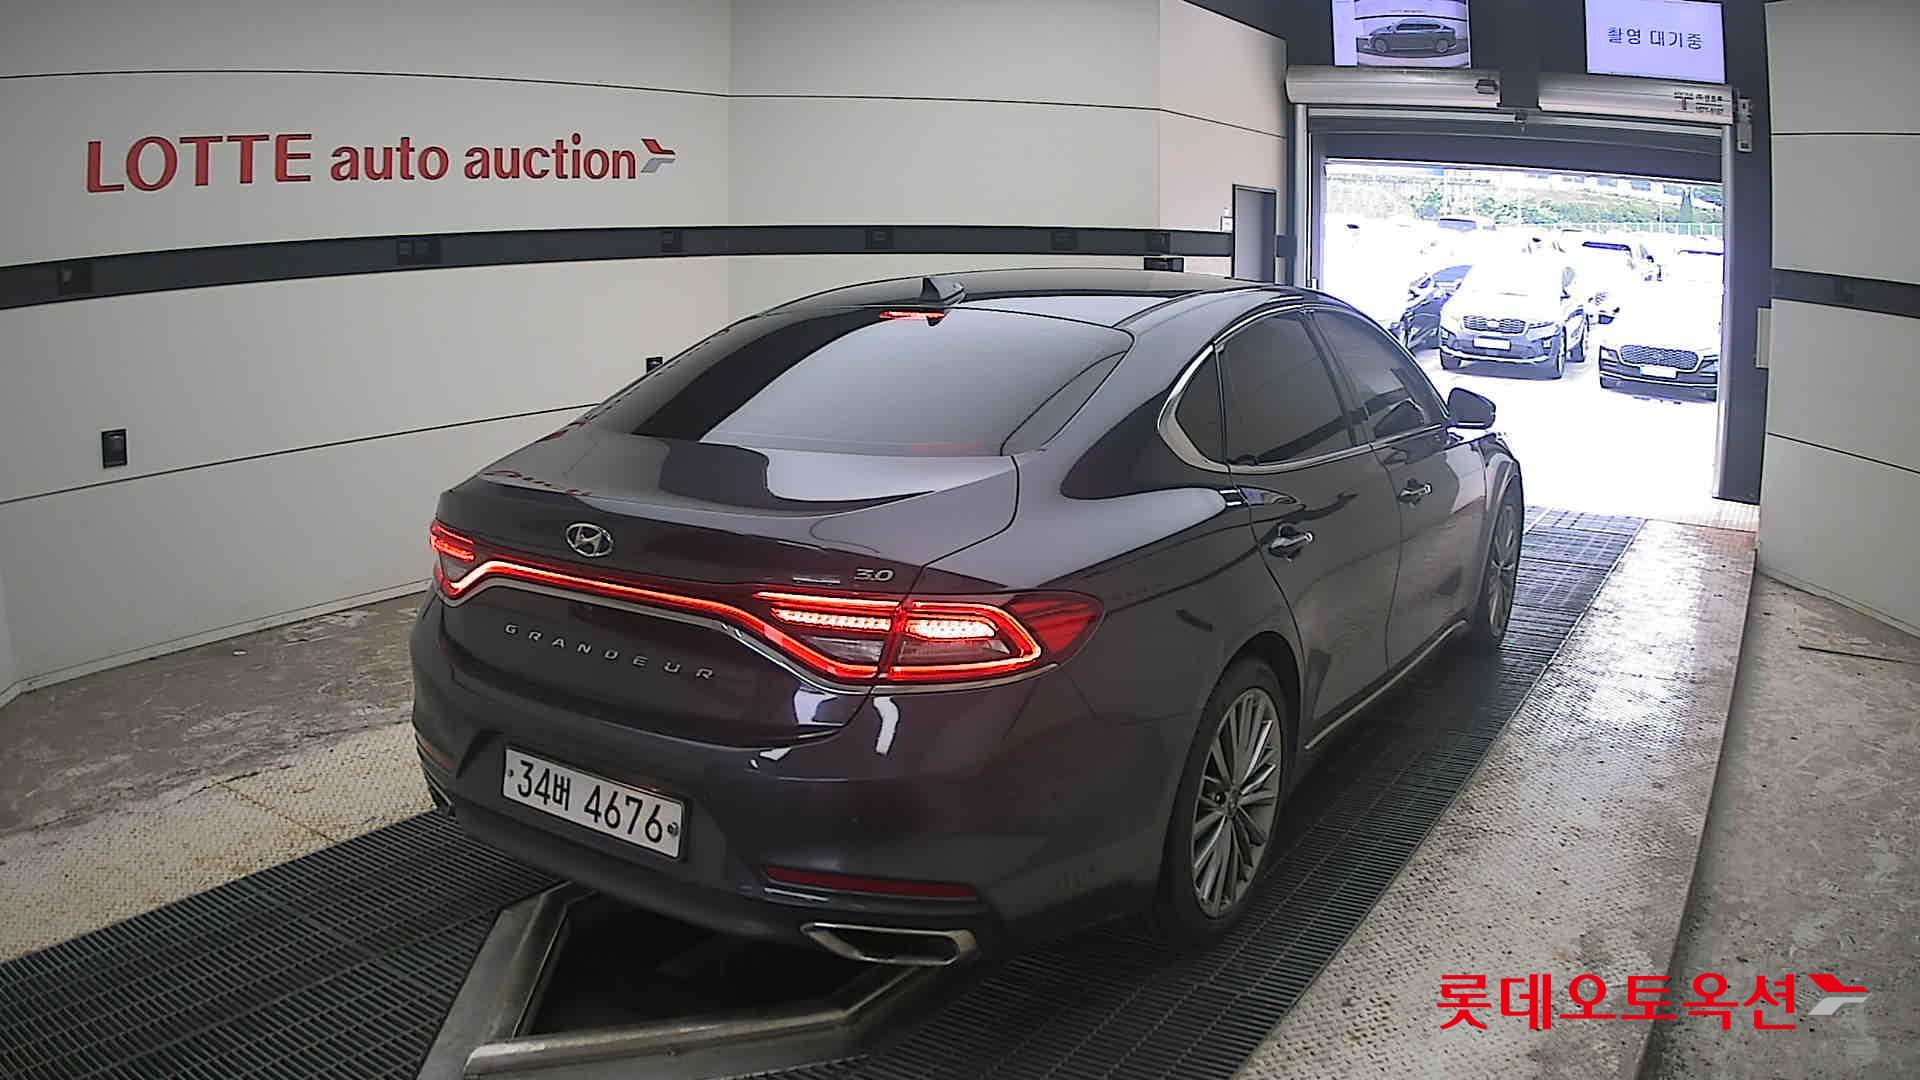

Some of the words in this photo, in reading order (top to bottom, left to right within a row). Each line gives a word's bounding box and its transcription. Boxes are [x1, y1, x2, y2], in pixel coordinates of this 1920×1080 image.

[1650, 30, 1702, 50] 대기중
[86, 133, 312, 193] LOTTE
[330, 136, 449, 181] auto
[463, 133, 637, 180] auction
[504, 623, 714, 680] GRANDEUR
[517, 759, 571, 811] 34버
[584, 785, 663, 843] 4676
